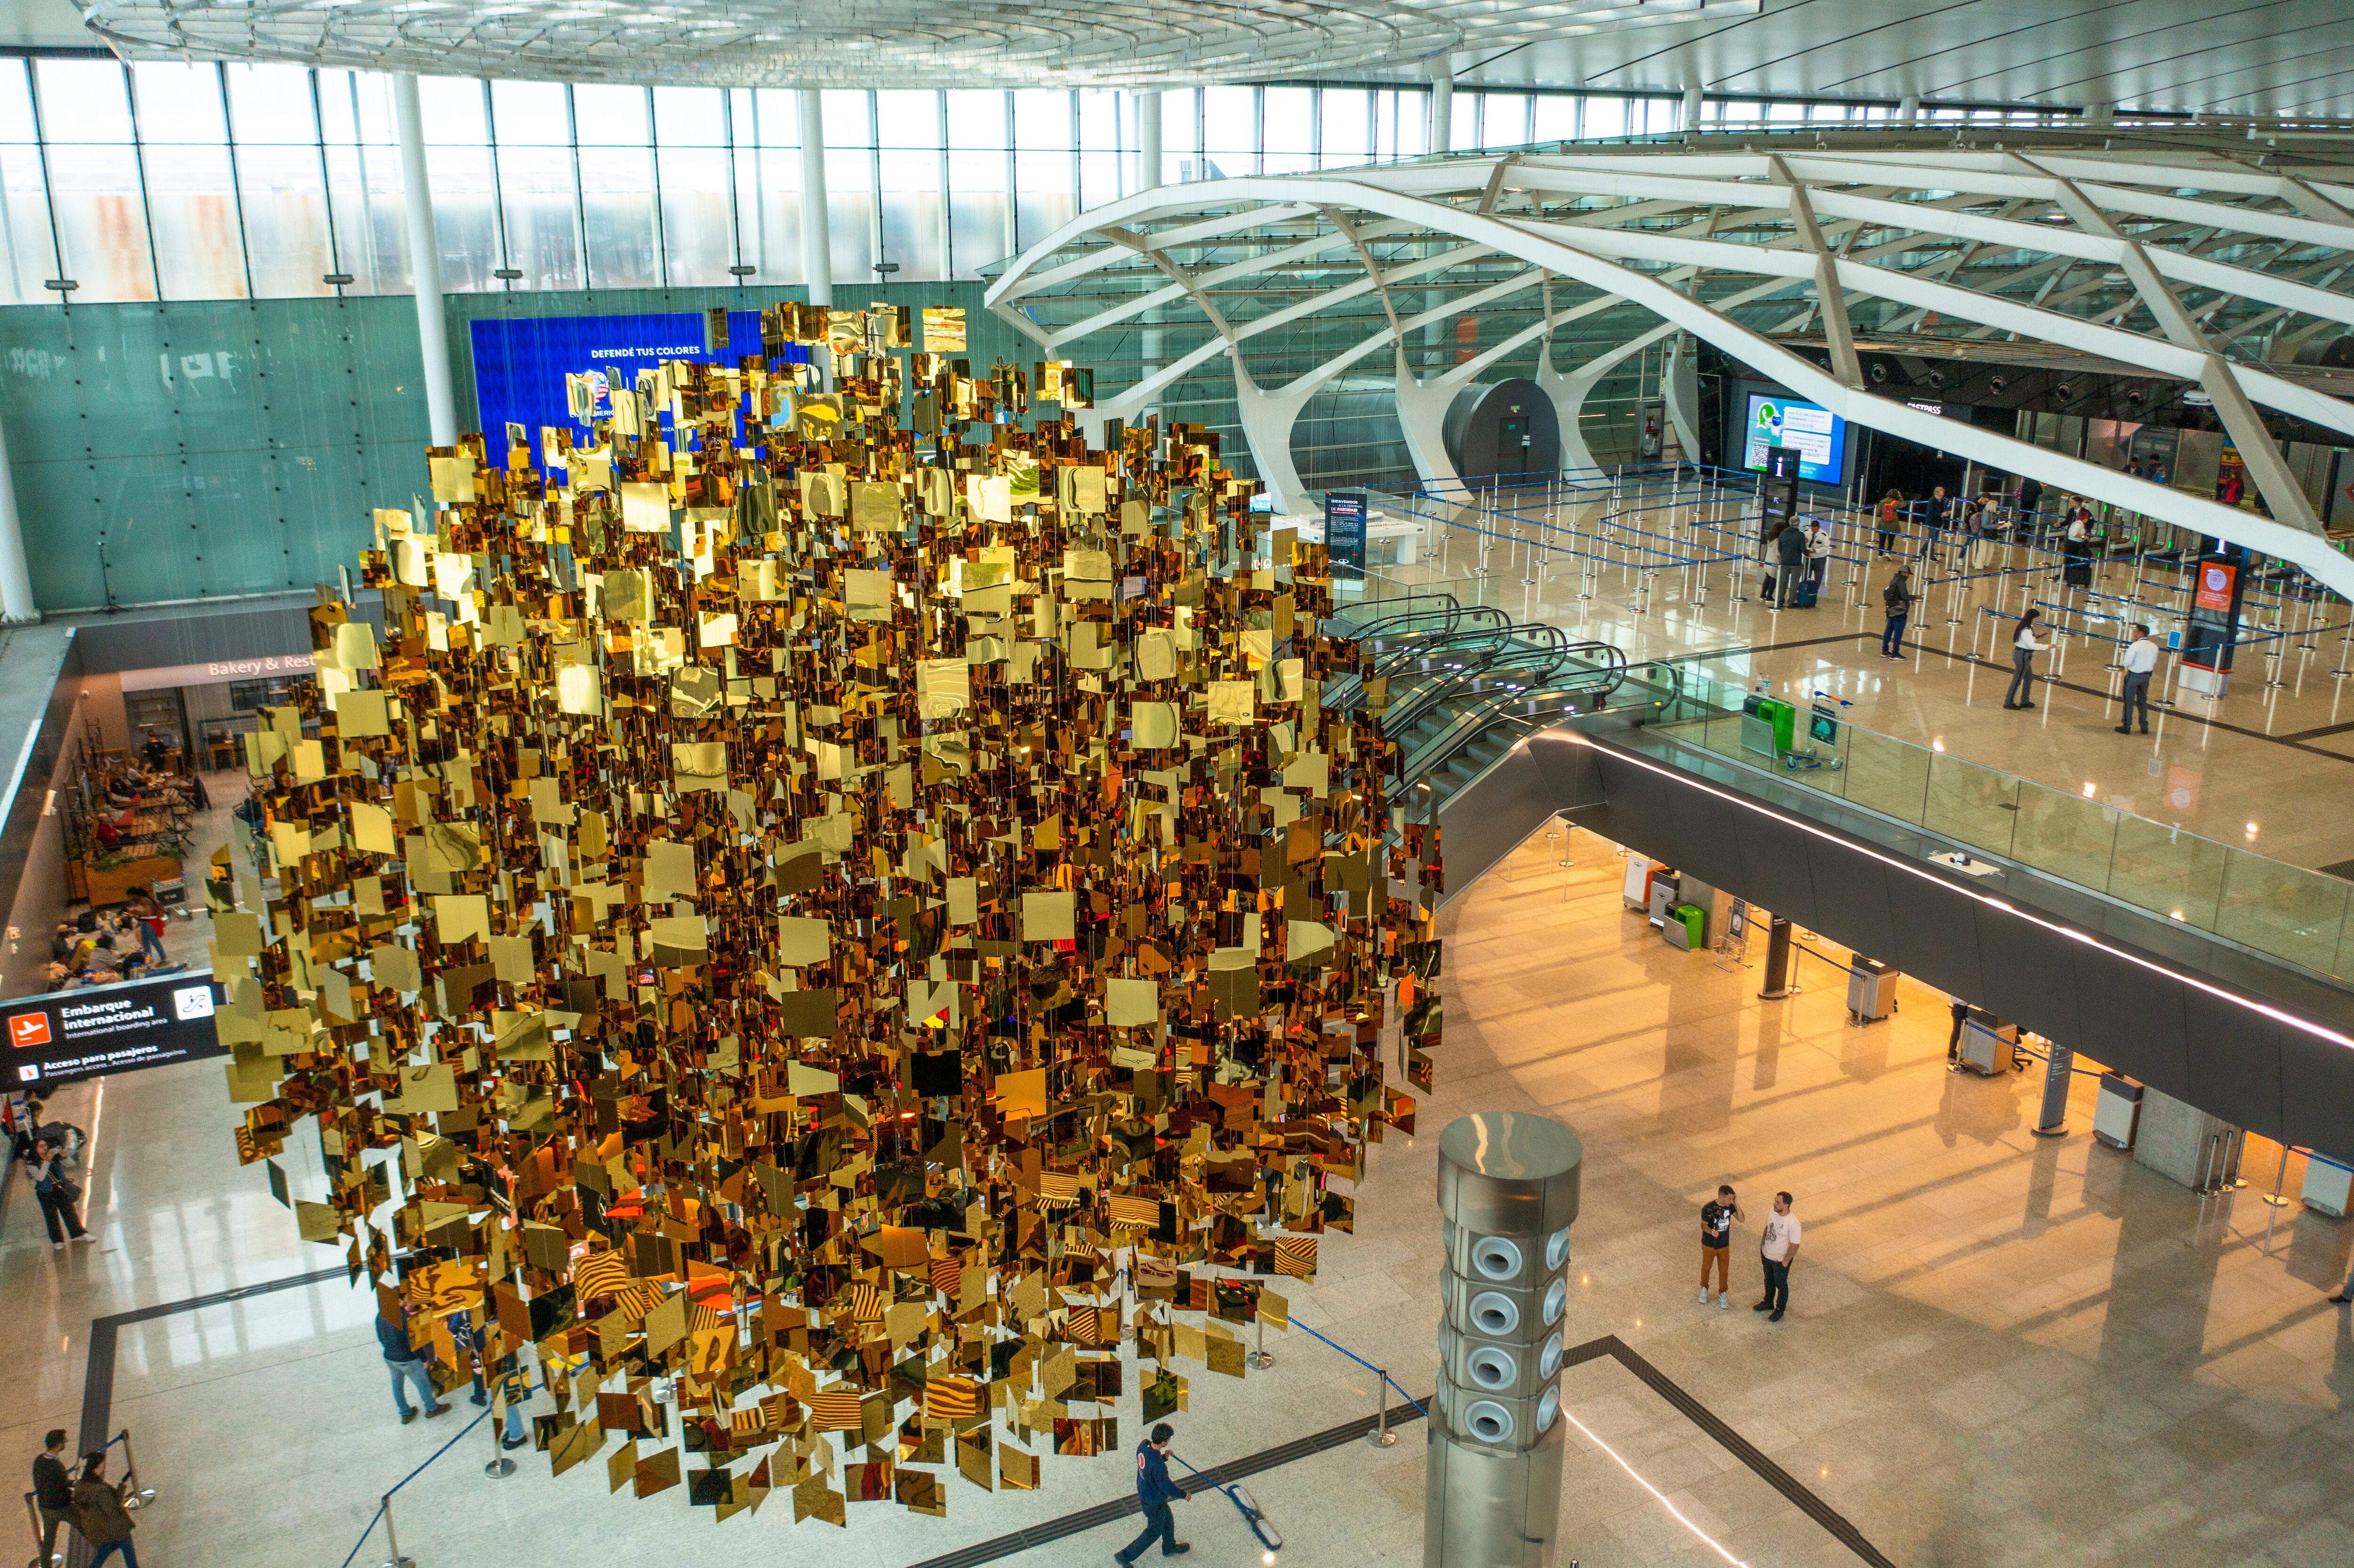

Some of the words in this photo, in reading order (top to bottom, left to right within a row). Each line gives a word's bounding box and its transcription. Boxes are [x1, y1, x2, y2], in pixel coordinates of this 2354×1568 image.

[591, 347, 634, 358] DEFENDÉ
[636, 348, 654, 356] TUS
[656, 346, 700, 355] COLORES
[210, 662, 261, 676] Bakery
[266, 657, 280, 670] &
[285, 654, 316, 668] Rest
[61, 1000, 132, 1018] Embarque
[64, 1006, 154, 1030] internacional
[66, 1026, 115, 1039] International
[116, 1021, 150, 1032] boarding
[44, 1058, 80, 1070] Acceso
[82, 1054, 106, 1065] para
[108, 1045, 158, 1061] pasajeros
